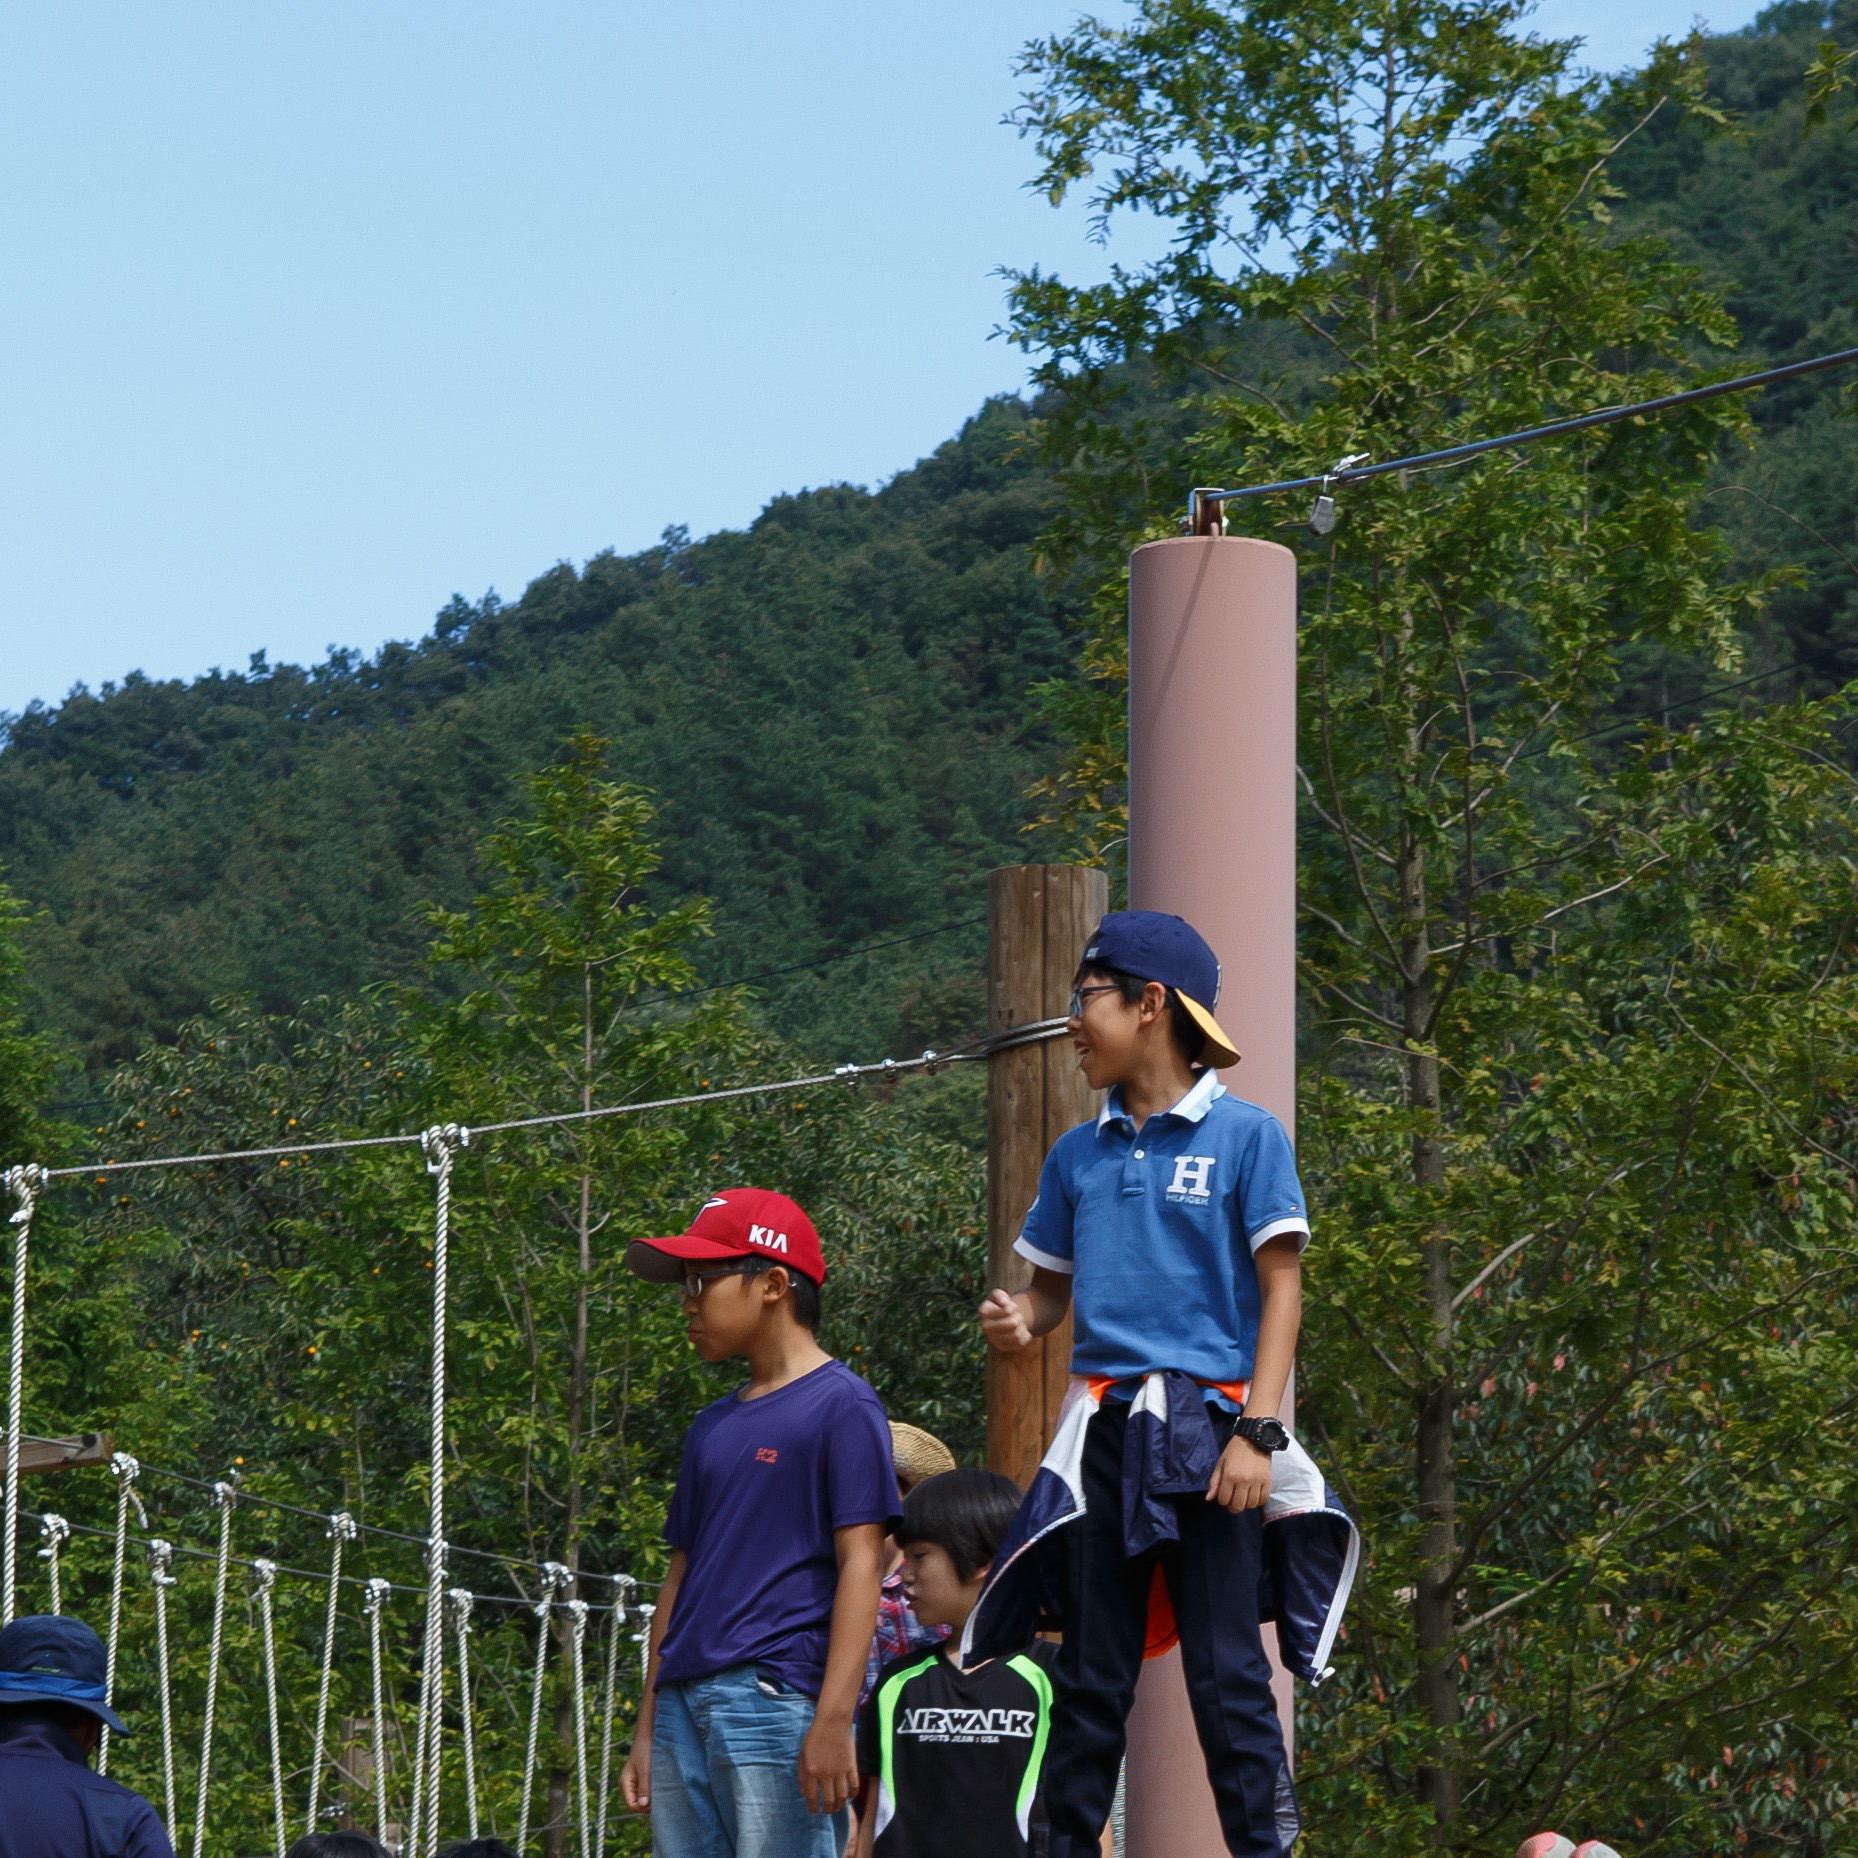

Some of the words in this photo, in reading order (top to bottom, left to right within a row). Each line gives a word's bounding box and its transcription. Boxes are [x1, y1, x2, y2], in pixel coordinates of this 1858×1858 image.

[1166, 1155, 1217, 1197] H
[748, 1223, 789, 1254] KIA
[897, 1708, 1036, 1738] AIRWALK
